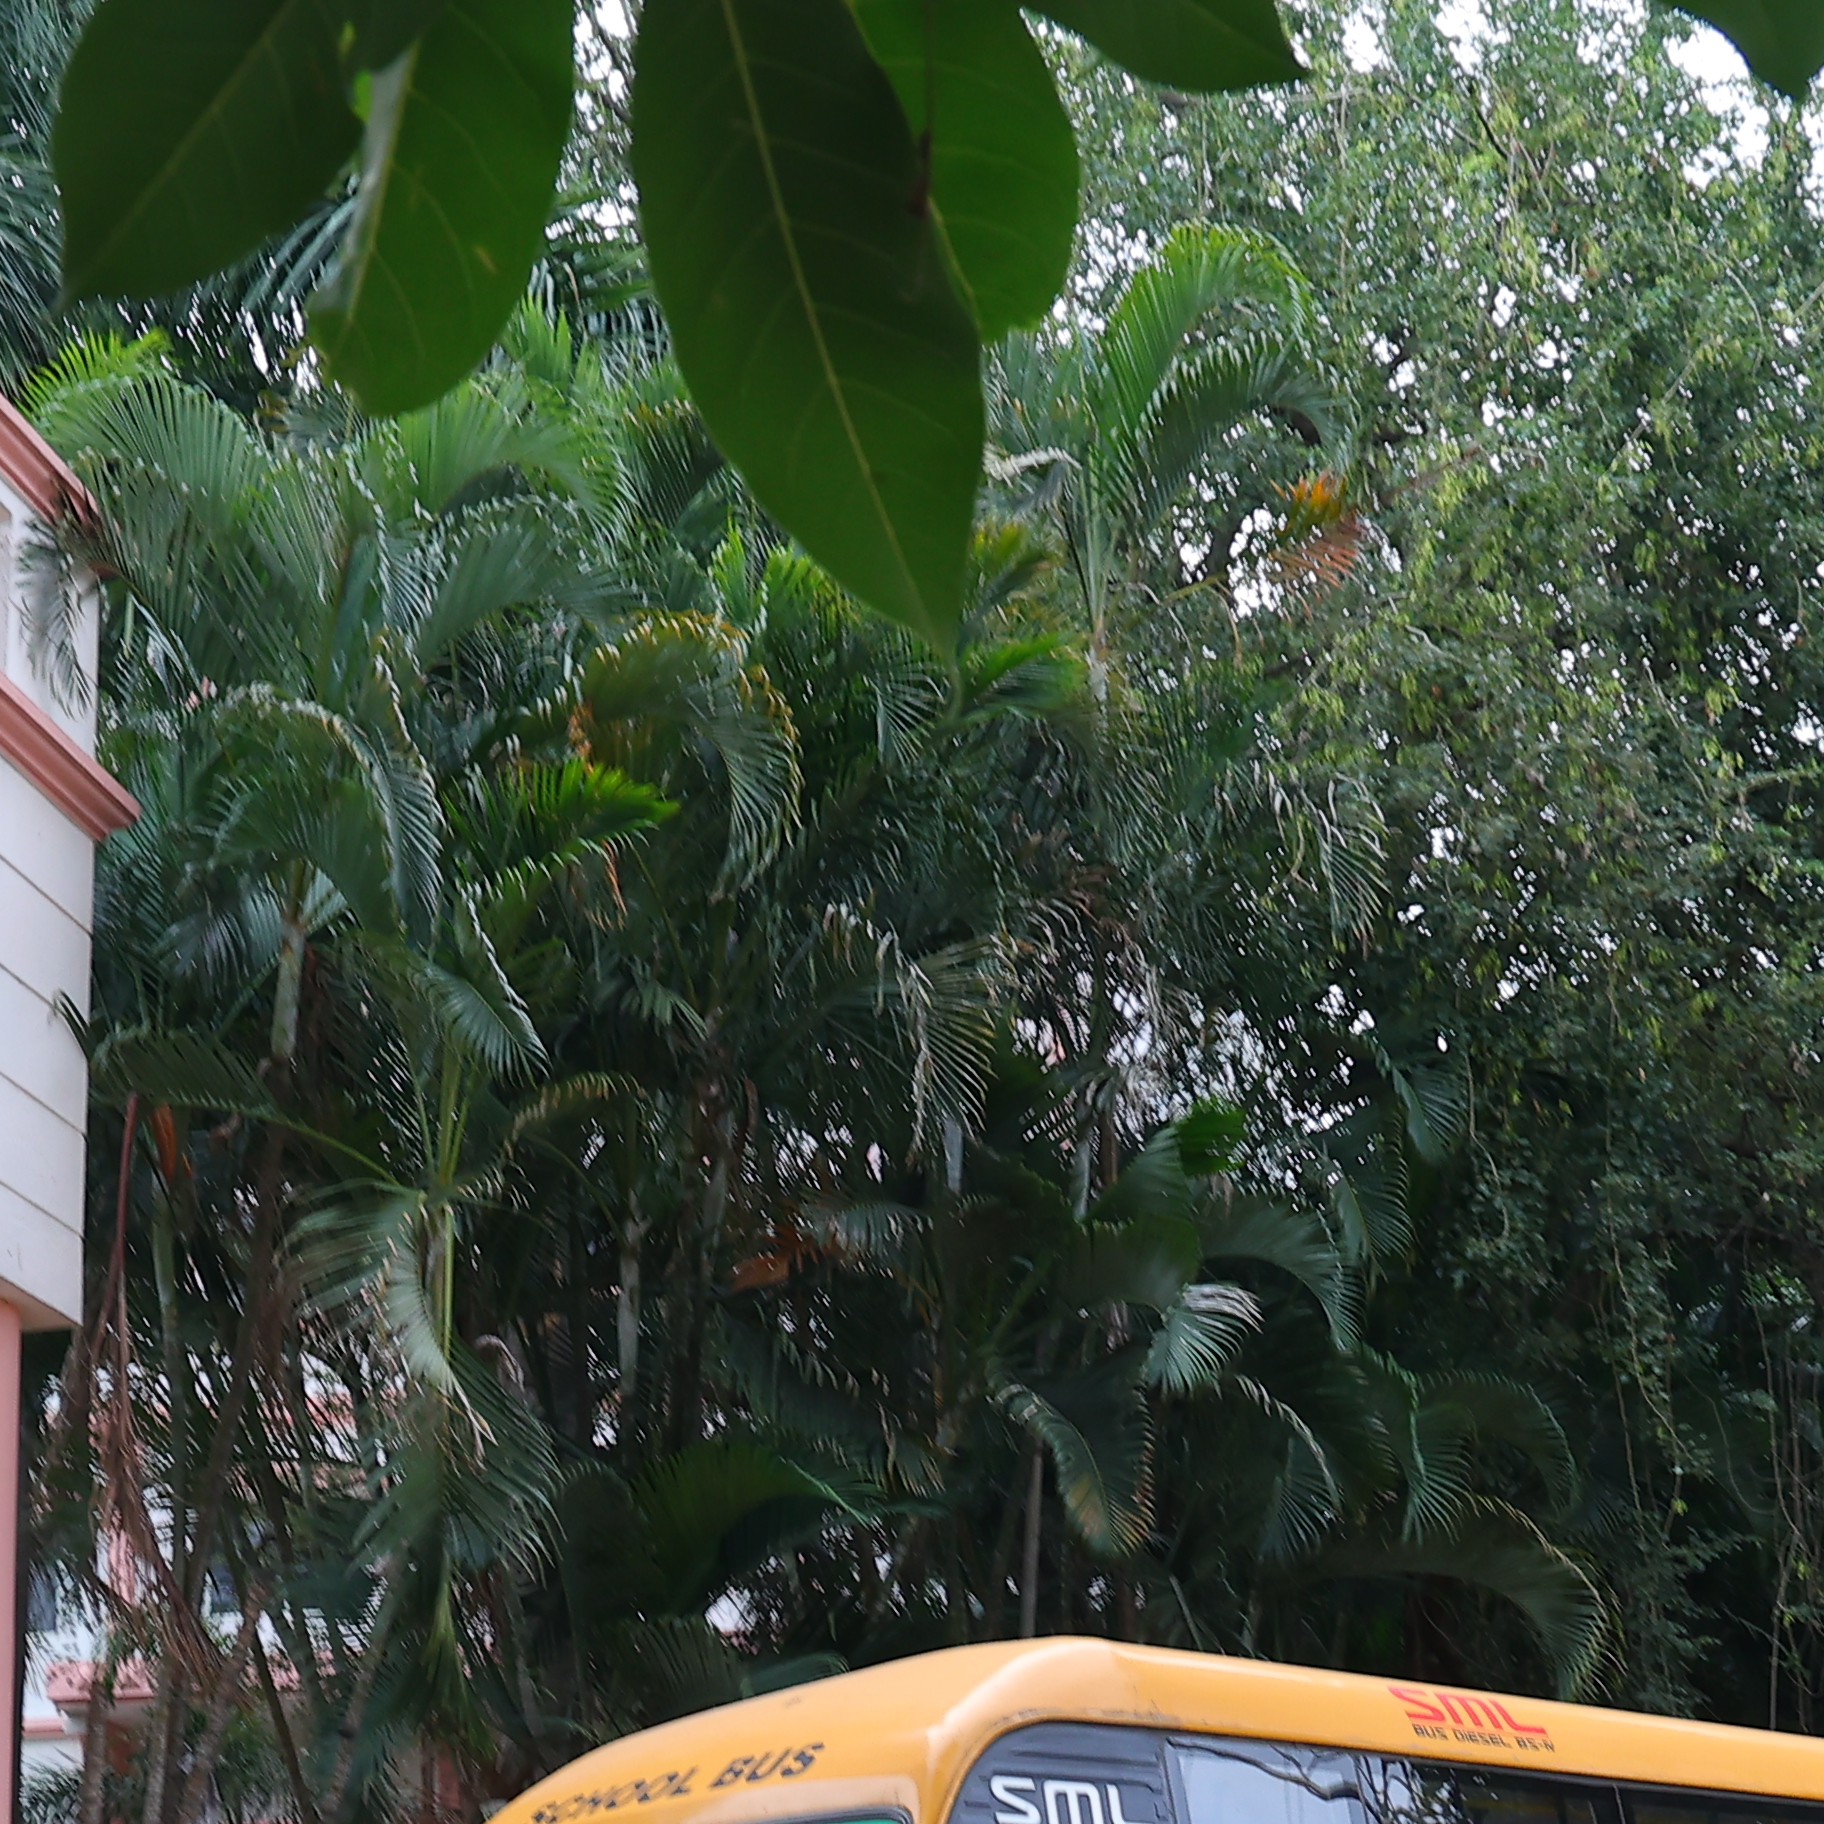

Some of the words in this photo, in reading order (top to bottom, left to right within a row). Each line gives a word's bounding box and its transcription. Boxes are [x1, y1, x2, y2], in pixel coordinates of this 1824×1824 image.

[1387, 1684, 1549, 1735] SML
[1412, 1723, 1450, 1741] BUS
[1454, 1728, 1513, 1749] DIESEL
[710, 1742, 825, 1788] BUS
